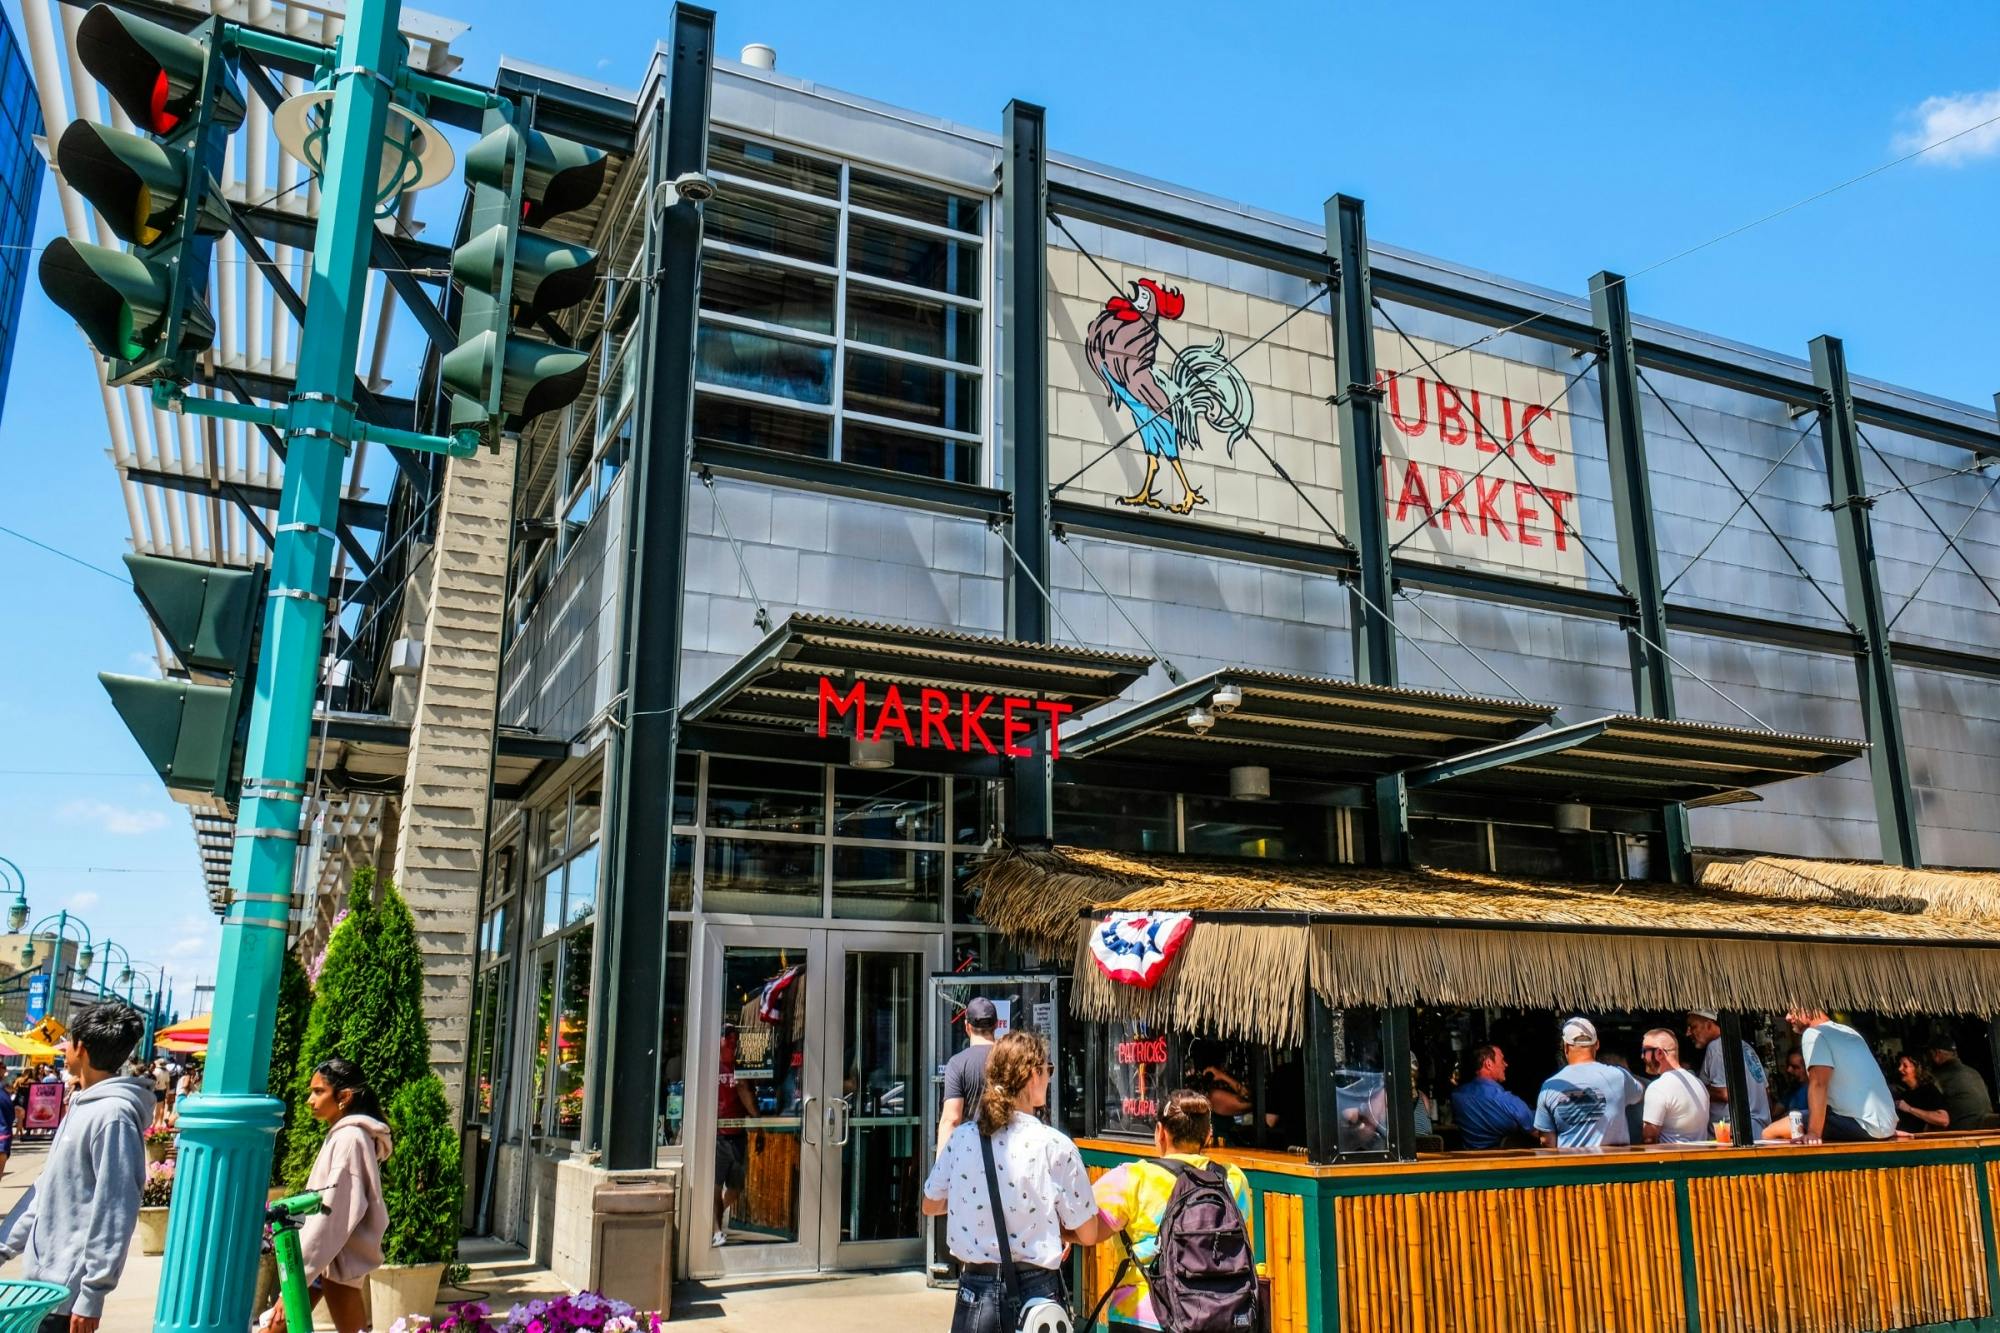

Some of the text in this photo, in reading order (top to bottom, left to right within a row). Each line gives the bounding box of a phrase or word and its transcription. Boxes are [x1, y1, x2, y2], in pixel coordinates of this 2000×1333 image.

[1376, 368, 1556, 467] UBLIC
[1381, 455, 1574, 552] ARKET
[818, 675, 1074, 760] MARKET
